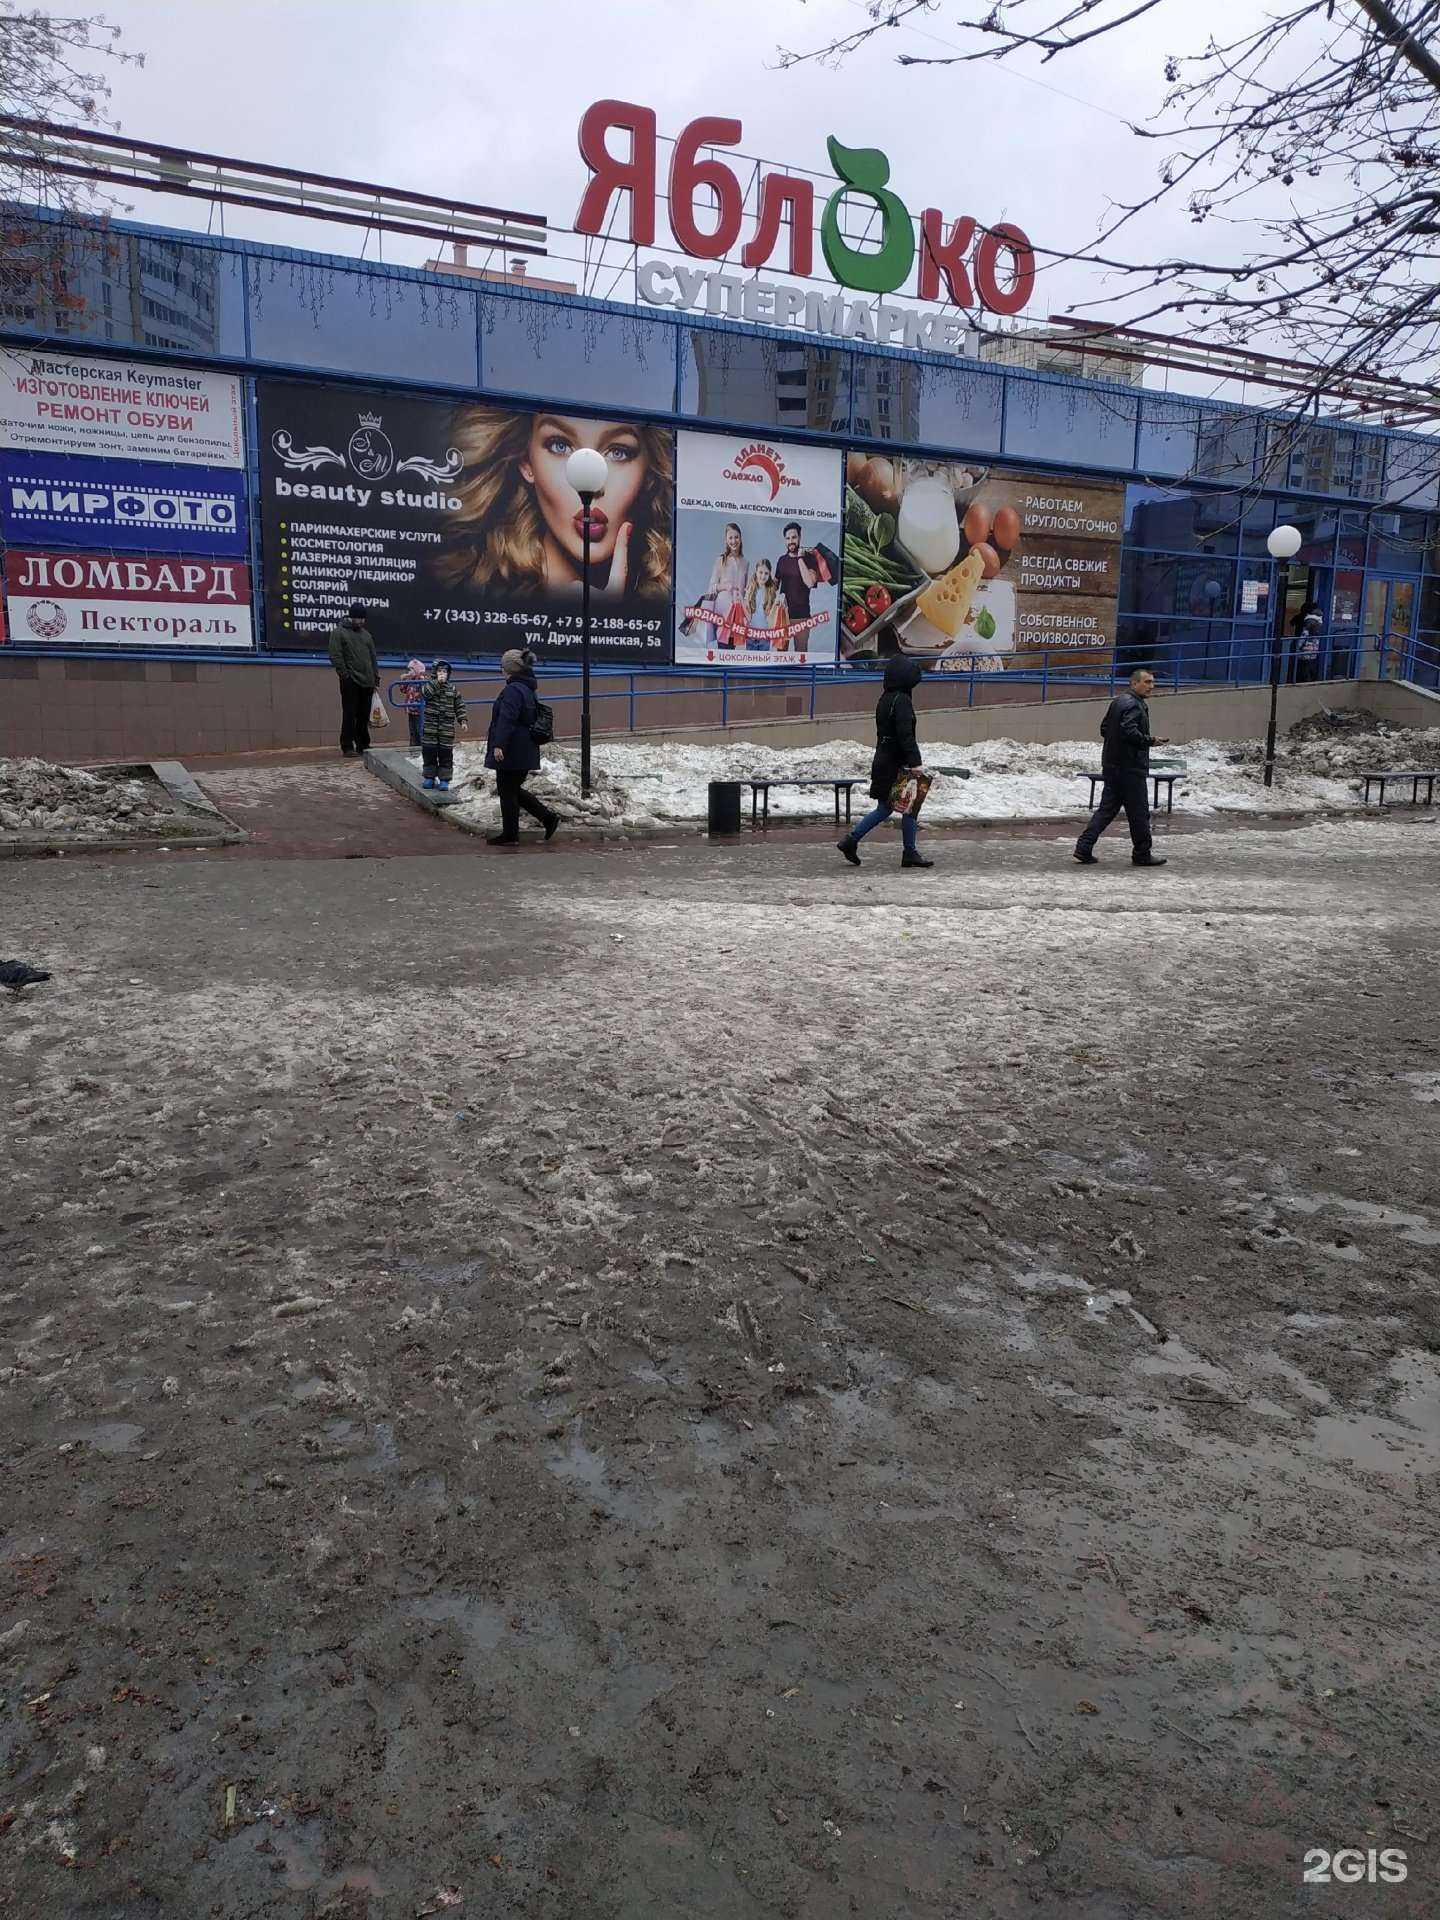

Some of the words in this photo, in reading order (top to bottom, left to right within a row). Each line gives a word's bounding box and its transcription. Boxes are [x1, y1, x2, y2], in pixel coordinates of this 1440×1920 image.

[637, 259, 988, 359] СУПЕРМАРКЕТ
[31, 359, 122, 381] Мастерская
[127, 369, 202, 391] Keymaster
[16, 377, 142, 406] ИЗГОТОВЛЕНИЕ
[146, 391, 209, 413] КЛЮЧЕЙ
[37, 401, 121, 424] РЕМОНТ
[127, 411, 193, 431] ОБУВИ
[10, 433, 96, 449] Отремонтируем
[734, 443, 787, 473] ПЛАНЕТА
[275, 477, 372, 507] beauty
[380, 488, 463, 511] studio
[680, 497, 714, 508] ОДЕЖДА,
[715, 500, 739, 511] ОБУВЬ,
[739, 503, 783, 515] АКСЕССУАРЫ
[784, 507, 798, 516] ДЛЯ
[798, 508, 815, 518] ВСЕЙ
[1025, 496, 1083, 513] РАБОТАЕМ
[290, 522, 396, 540] ПАРИКМАХЕРСКИЕ
[399, 531, 442, 544] УСЛУГИ
[1024, 514, 1118, 534] КРУГЛОСУТОЧНО
[290, 537, 384, 553] КОСМЕТОЛОГИЯ
[290, 551, 351, 565] ЛАЗЕРНАЯ
[354, 556, 417, 570] ЭПИЛЯЦИЯ
[1022, 555, 1063, 571] ВСЕГДА
[1065, 558, 1108, 573] СВЕЖИЕ
[19, 557, 237, 600] ЛОМБАРД
[292, 565, 415, 582] МАНИКЮР/ПЕДИКЮР
[1020, 573, 1081, 589] ПРОДУКТЫ
[292, 579, 349, 592] СОЛЯРИЙ
[293, 607, 350, 619] ШУГАРИН
[423, 608, 442, 620] +7
[445, 609, 481, 625] (343)
[484, 611, 552, 628] 328-65-67,
[556, 615, 573, 628] +7
[575, 616, 662, 632] 92-188-65-67
[1019, 614, 1099, 629] СОБСТВЕННОЕ
[80, 610, 238, 638] Пектораль
[685, 607, 725, 627] МОДНО
[732, 624, 746, 635] НЕ
[748, 628, 786, 640] ЗНАЧИТ
[788, 611, 830, 638] ДОРОГО!
[525, 631, 545, 645] ул.
[547, 631, 644, 648] Дружнинская,
[647, 635, 662, 647] 5а
[1018, 631, 1106, 647] ПРОИЗВОДСТВО
[719, 653, 771, 664] ЦОКОЛЬНЫЙ
[773, 655, 796, 664] ЭТАЖ
